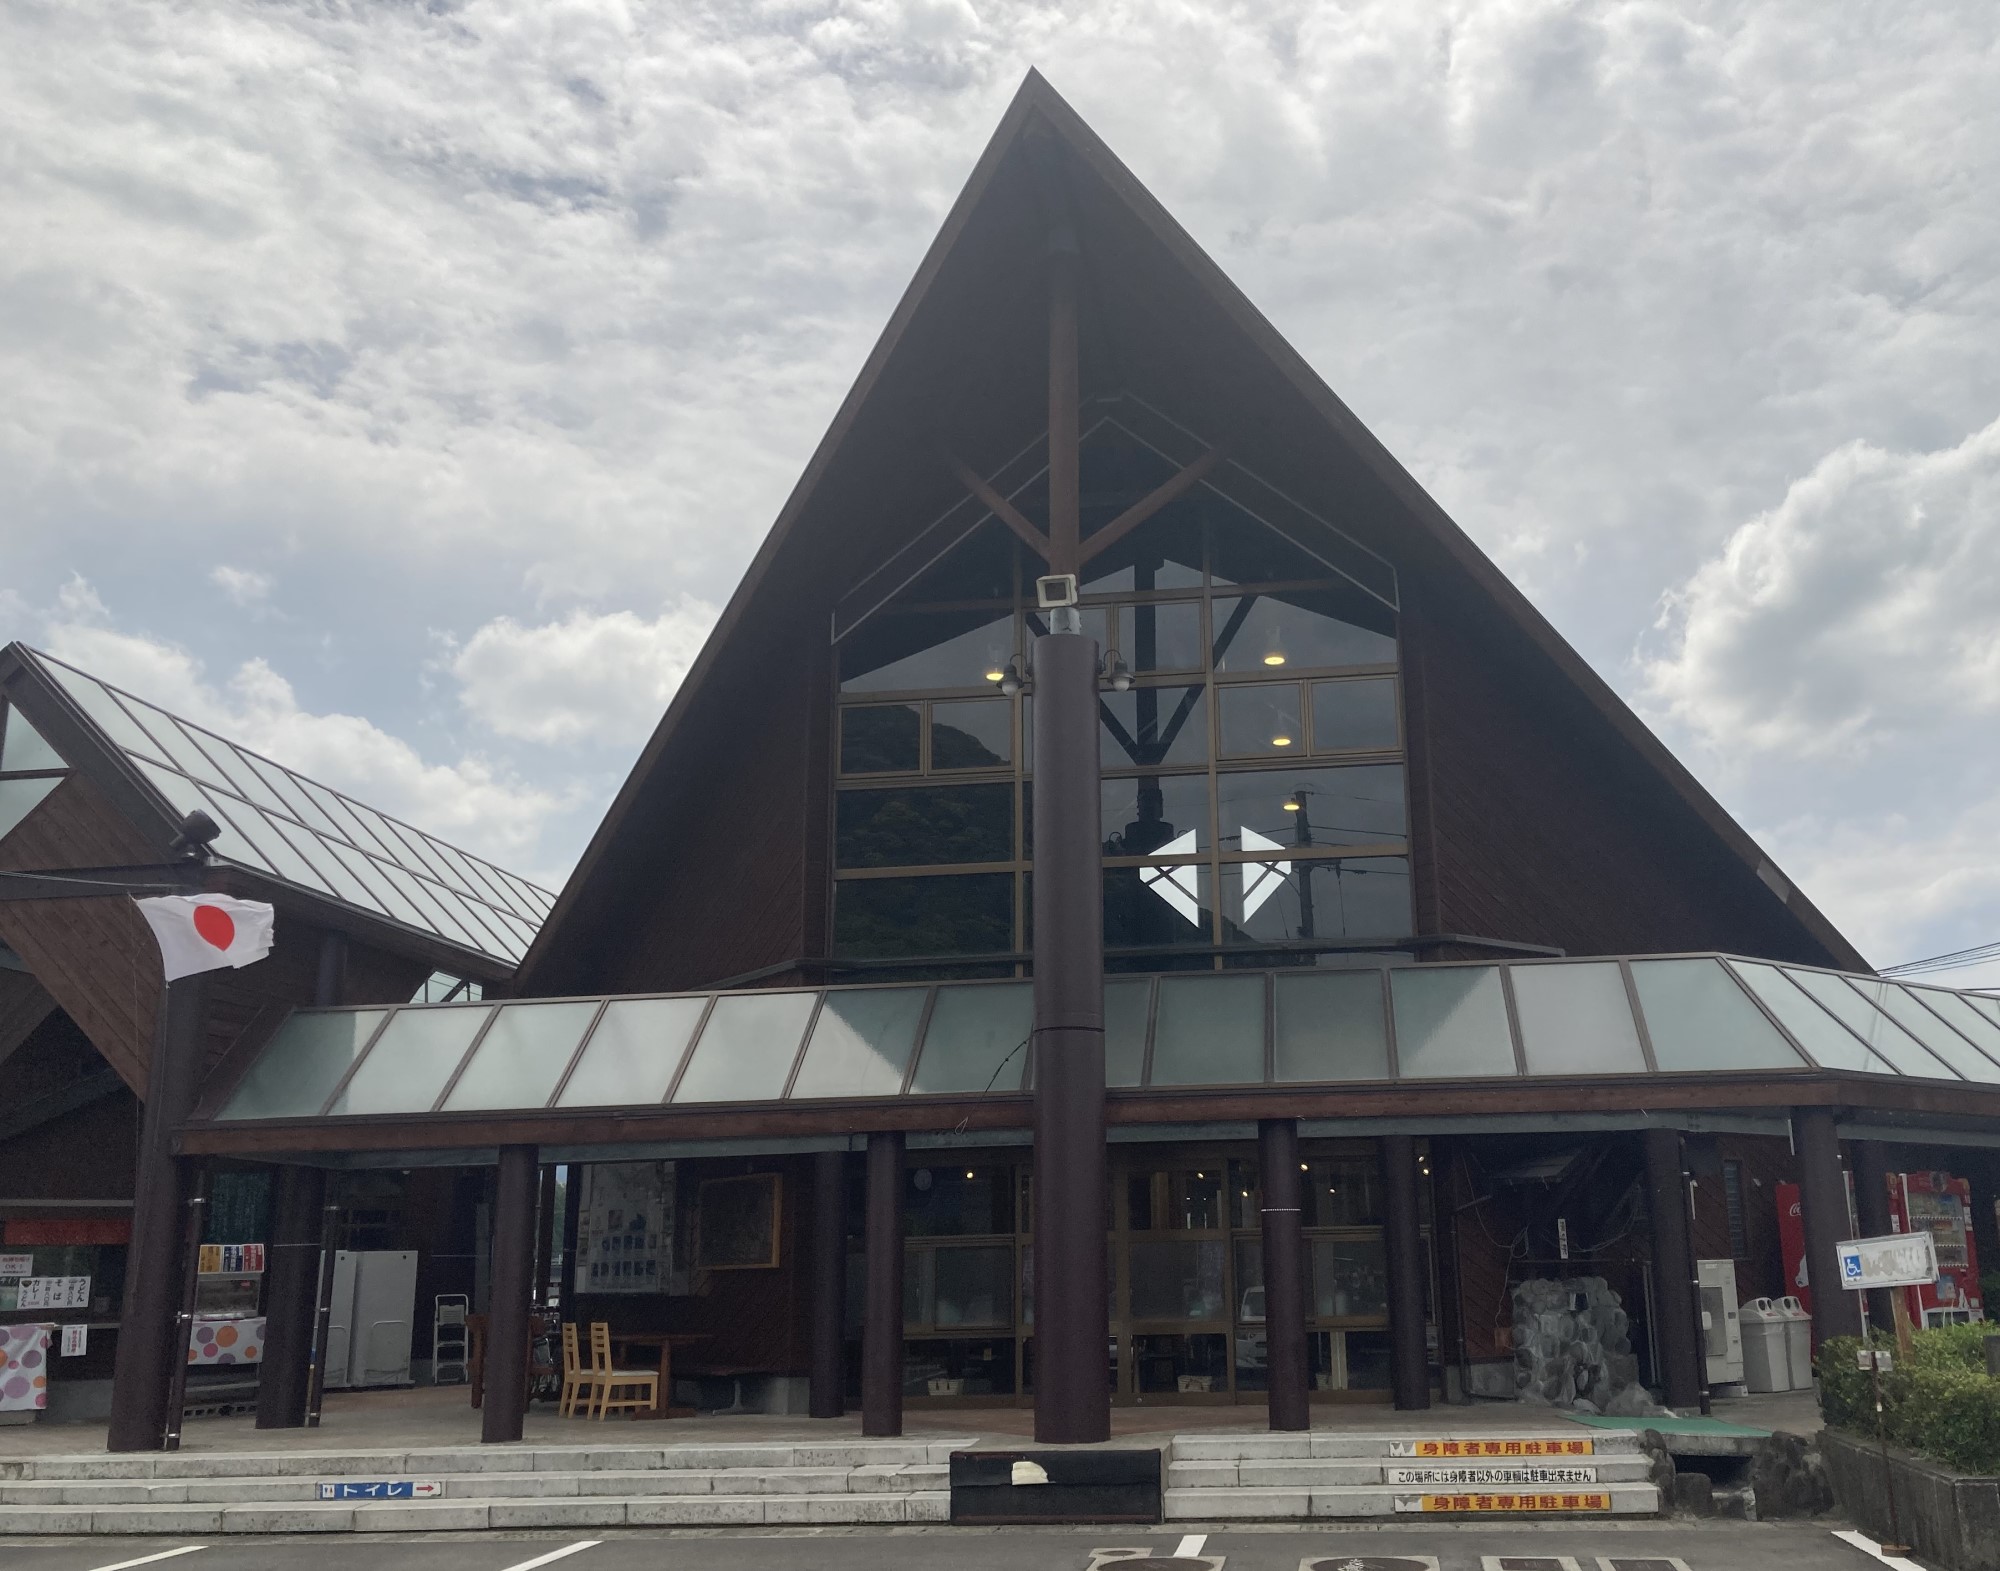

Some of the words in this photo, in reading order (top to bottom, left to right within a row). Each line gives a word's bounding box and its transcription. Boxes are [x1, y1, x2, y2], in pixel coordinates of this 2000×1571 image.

[53, 1279, 63, 1301] そば
[1423, 1441, 1584, 1455] 身障者専用駐車場
[343, 1484, 402, 1497] トイレ
[1433, 1495, 1602, 1510] 身障者専用駐車場
